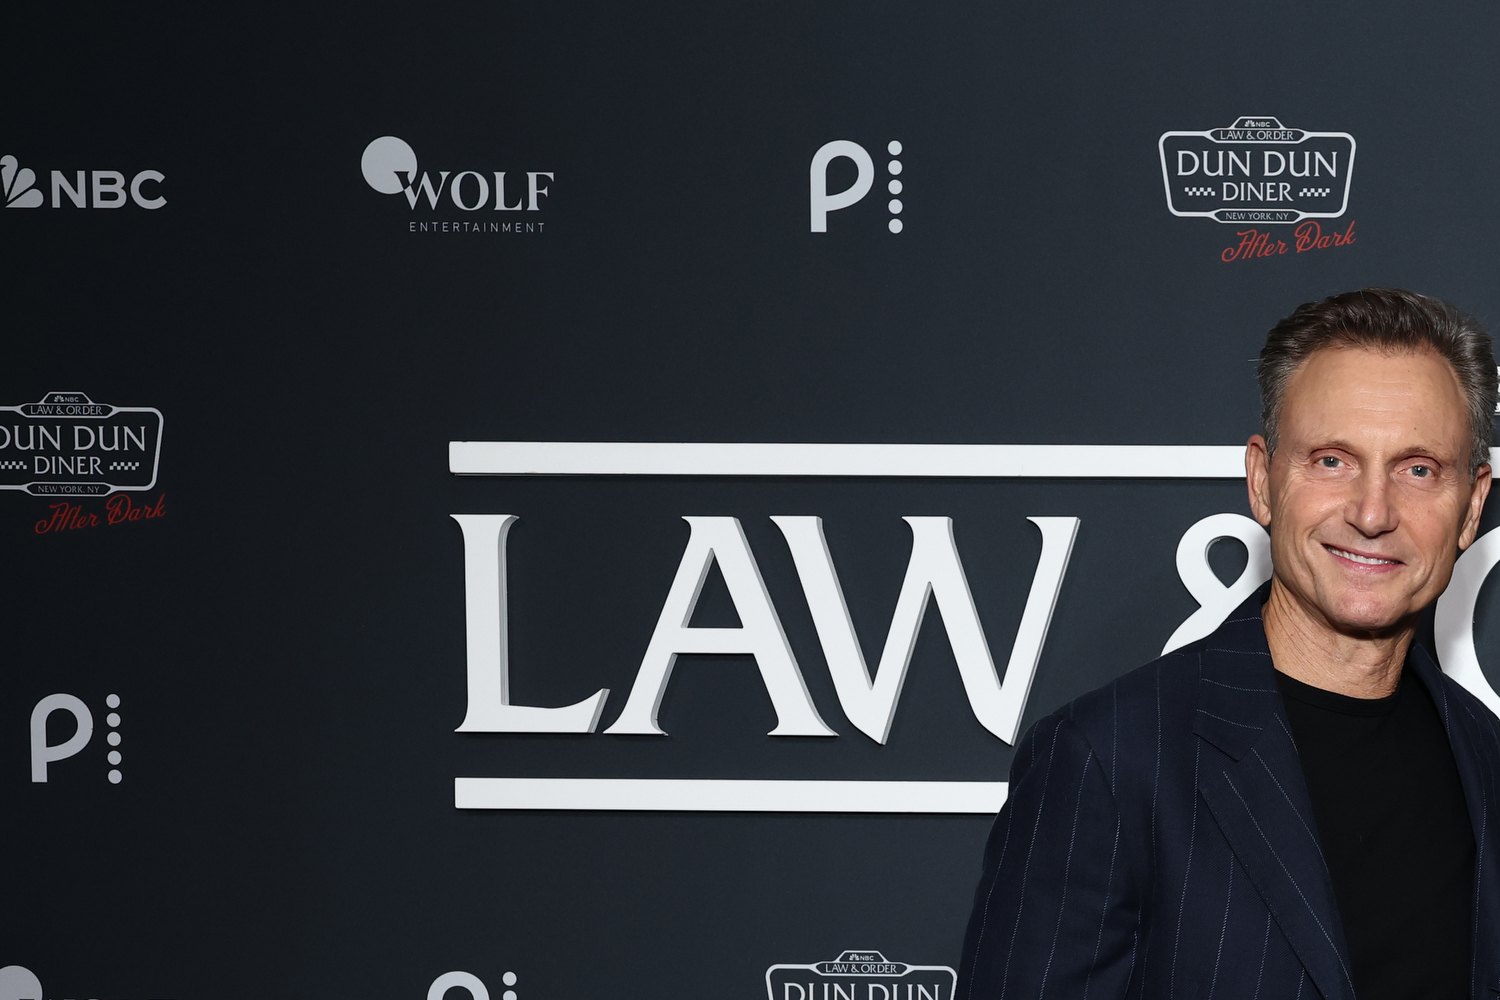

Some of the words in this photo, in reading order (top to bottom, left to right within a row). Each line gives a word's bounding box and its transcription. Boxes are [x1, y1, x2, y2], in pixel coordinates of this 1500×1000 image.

[1220, 131, 1244, 140] LAW
[1246, 131, 1256, 140] &
[1256, 131, 1294, 141] ORDER
[1177, 151, 1251, 177] DUN
[1264, 151, 1338, 177] DUN
[51, 170, 167, 209] NBC
[394, 171, 554, 210] WOLF
[1222, 182, 1294, 202] DINER
[1226, 212, 1244, 220] NEW
[410, 222, 544, 232] ENTERTAINMENT
[1221, 229, 1289, 263] After
[1295, 220, 1356, 253] Dark
[30, 406, 53, 415] LAW
[56, 406, 65, 415] &
[66, 406, 102, 415] ORDER
[74, 426, 146, 451] DUN
[34, 456, 104, 475] DINER
[38, 485, 56, 493] NEW
[34, 502, 101, 535] After
[106, 493, 166, 525] Dark
[450, 514, 1081, 746] LAW
[825, 964, 848, 973] LAW
[851, 964, 860, 973] &
[861, 965, 897, 974] ORDER
